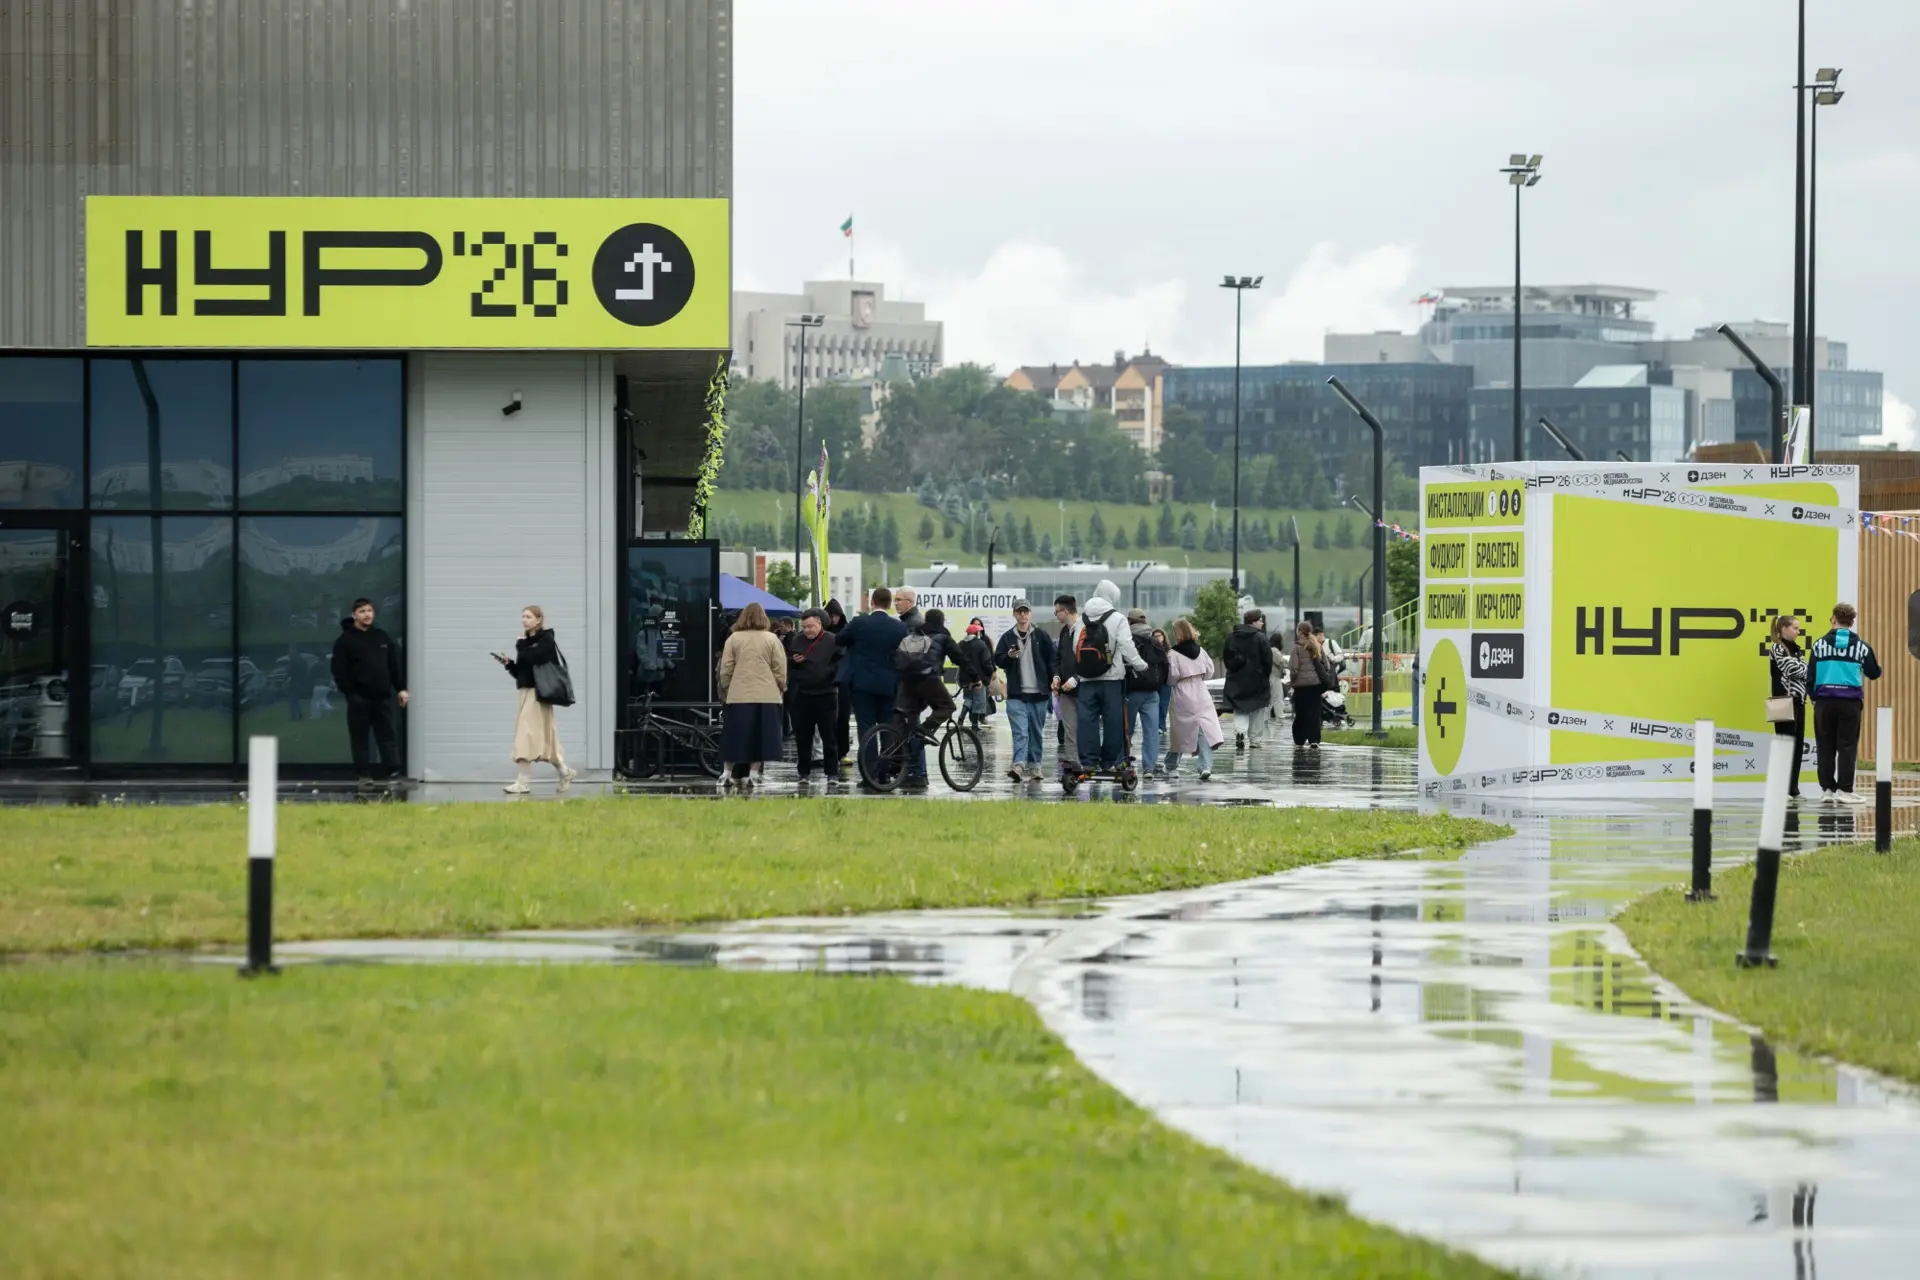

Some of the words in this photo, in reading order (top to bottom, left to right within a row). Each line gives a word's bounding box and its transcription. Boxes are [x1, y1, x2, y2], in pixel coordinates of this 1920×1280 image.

[1701, 471, 1727, 481] дзен
[1428, 492, 1484, 521] ИНСТАЛЛЯЦИИ
[1804, 511, 1831, 520] дзен
[1430, 543, 1465, 573] ФУДКОРТ
[1476, 542, 1519, 568] БРАСЛЕТЫ
[916, 593, 943, 608] АРТА
[946, 592, 979, 608] МЕЙН
[1428, 588, 1466, 619] ЛЕКТОРИЙ
[1476, 594, 1498, 619] МЕРЧ
[1500, 594, 1521, 619] СТОР
[1491, 648, 1513, 666] дзен
[1560, 716, 1587, 726] дзен
[1712, 761, 1729, 770] зен
